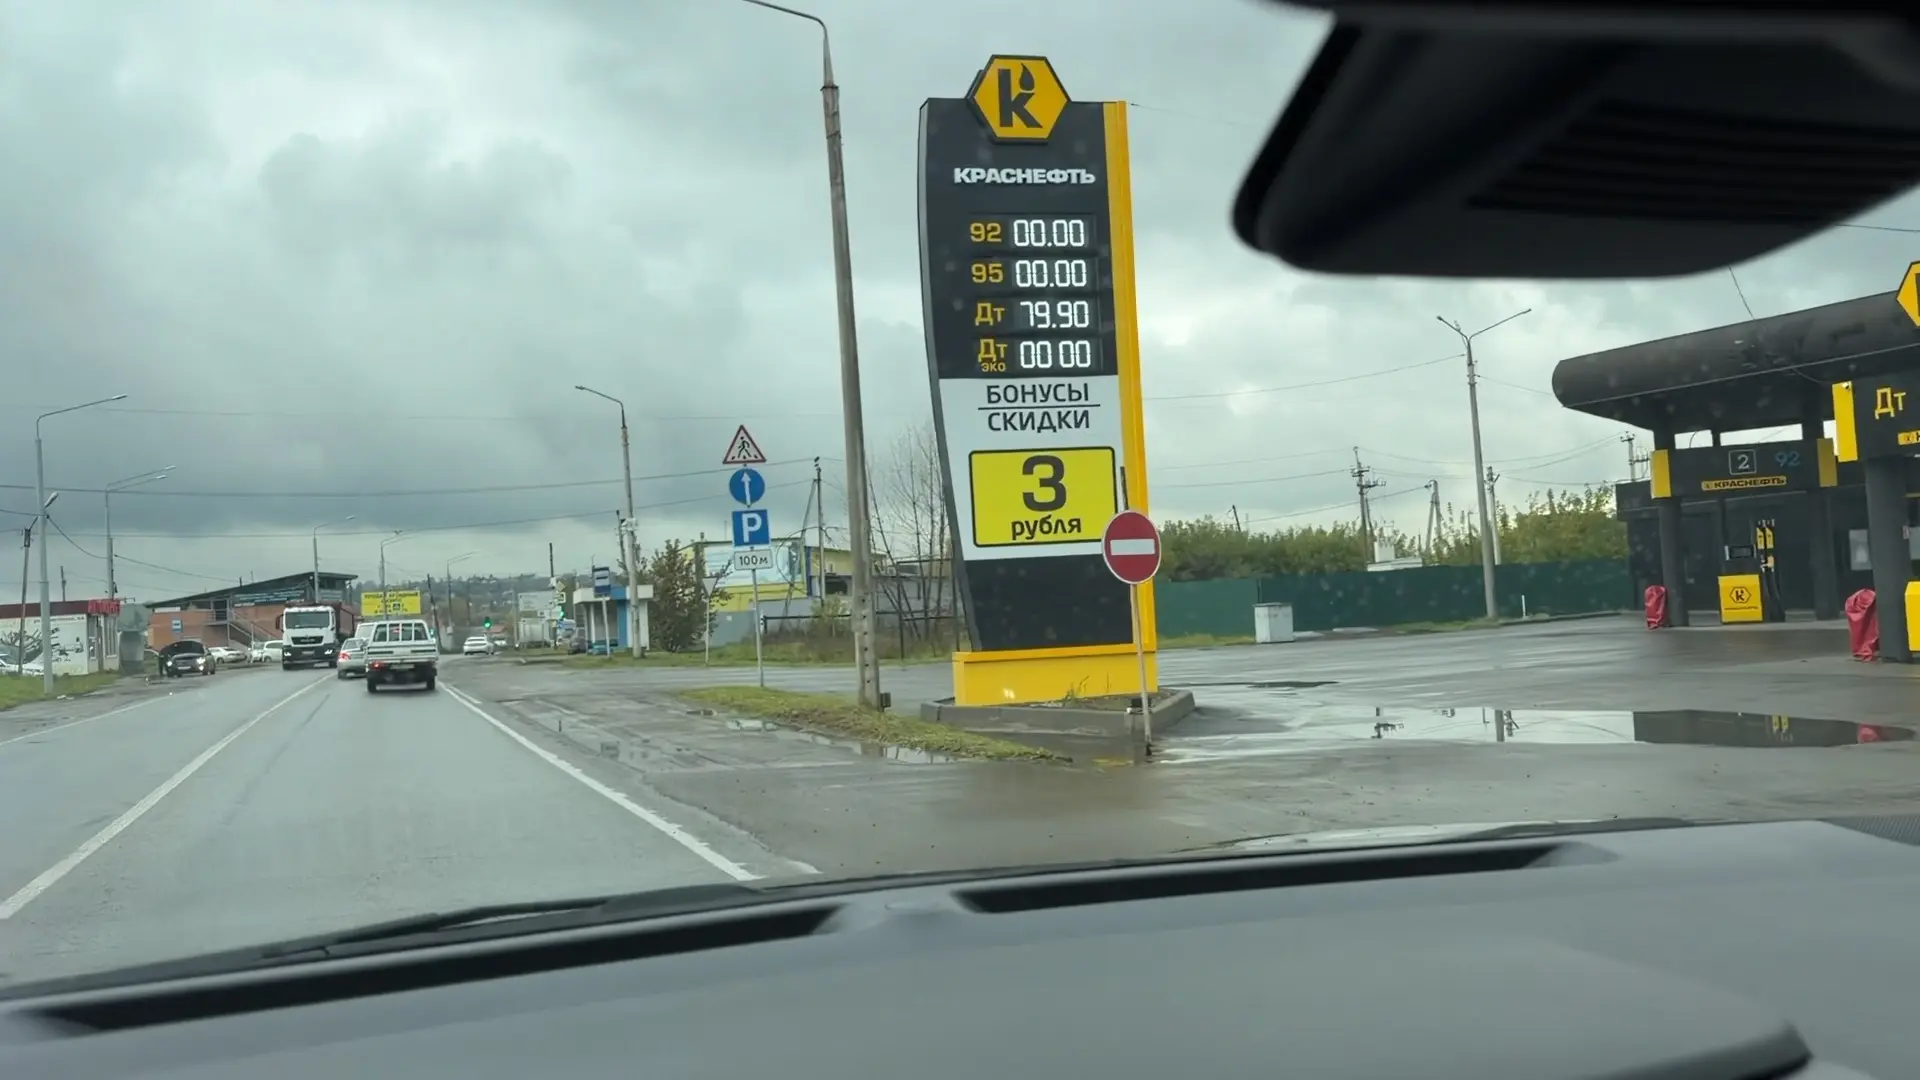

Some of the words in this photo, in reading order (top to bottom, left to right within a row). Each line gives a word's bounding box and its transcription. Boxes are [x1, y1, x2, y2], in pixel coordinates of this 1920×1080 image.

[954, 167, 1096, 184] КРАСНЕФТЬ
[970, 222, 1002, 242] 92
[1013, 219, 1085, 247] 00.00
[971, 263, 1004, 283] 95
[1015, 259, 1086, 287] 00.00
[975, 302, 1005, 326] Дт
[1020, 301, 1089, 329] 79.90
[978, 339, 1007, 363] Дт
[987, 383, 1089, 404] БОНУСЫ
[1874, 387, 1907, 419] Дт
[988, 410, 1090, 433] СКИДКИ
[1737, 454, 1749, 469] 2
[1775, 451, 1800, 467] 92
[1022, 455, 1067, 512] 3
[1714, 477, 1784, 488] КРАСНЕФТЬ
[742, 513, 762, 543] P
[1011, 515, 1081, 540] рубля
